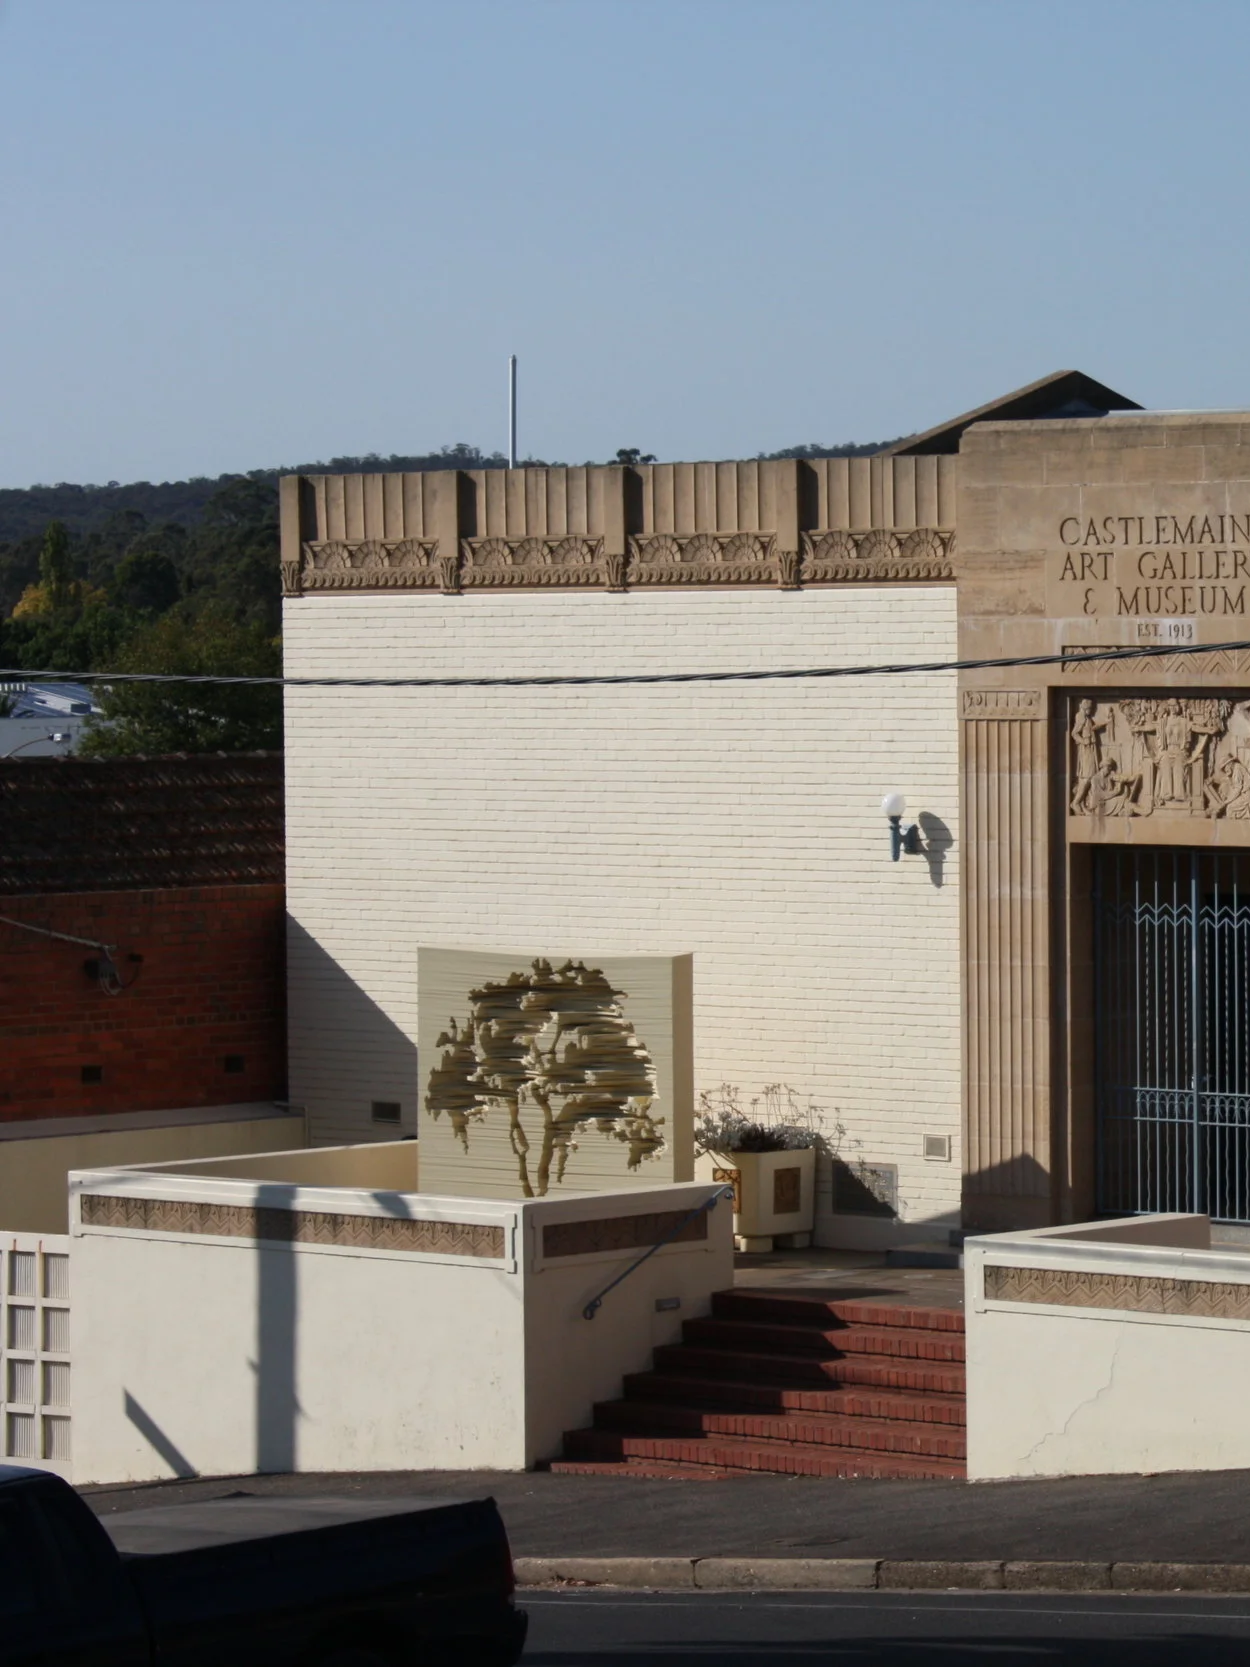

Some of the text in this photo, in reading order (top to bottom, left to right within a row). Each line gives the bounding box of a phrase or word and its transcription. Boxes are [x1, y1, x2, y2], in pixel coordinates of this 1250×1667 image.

[1059, 552, 1114, 581] ART
[1116, 585, 1246, 616] MUSEUM
[1137, 623, 1193, 638] EST. 1913
